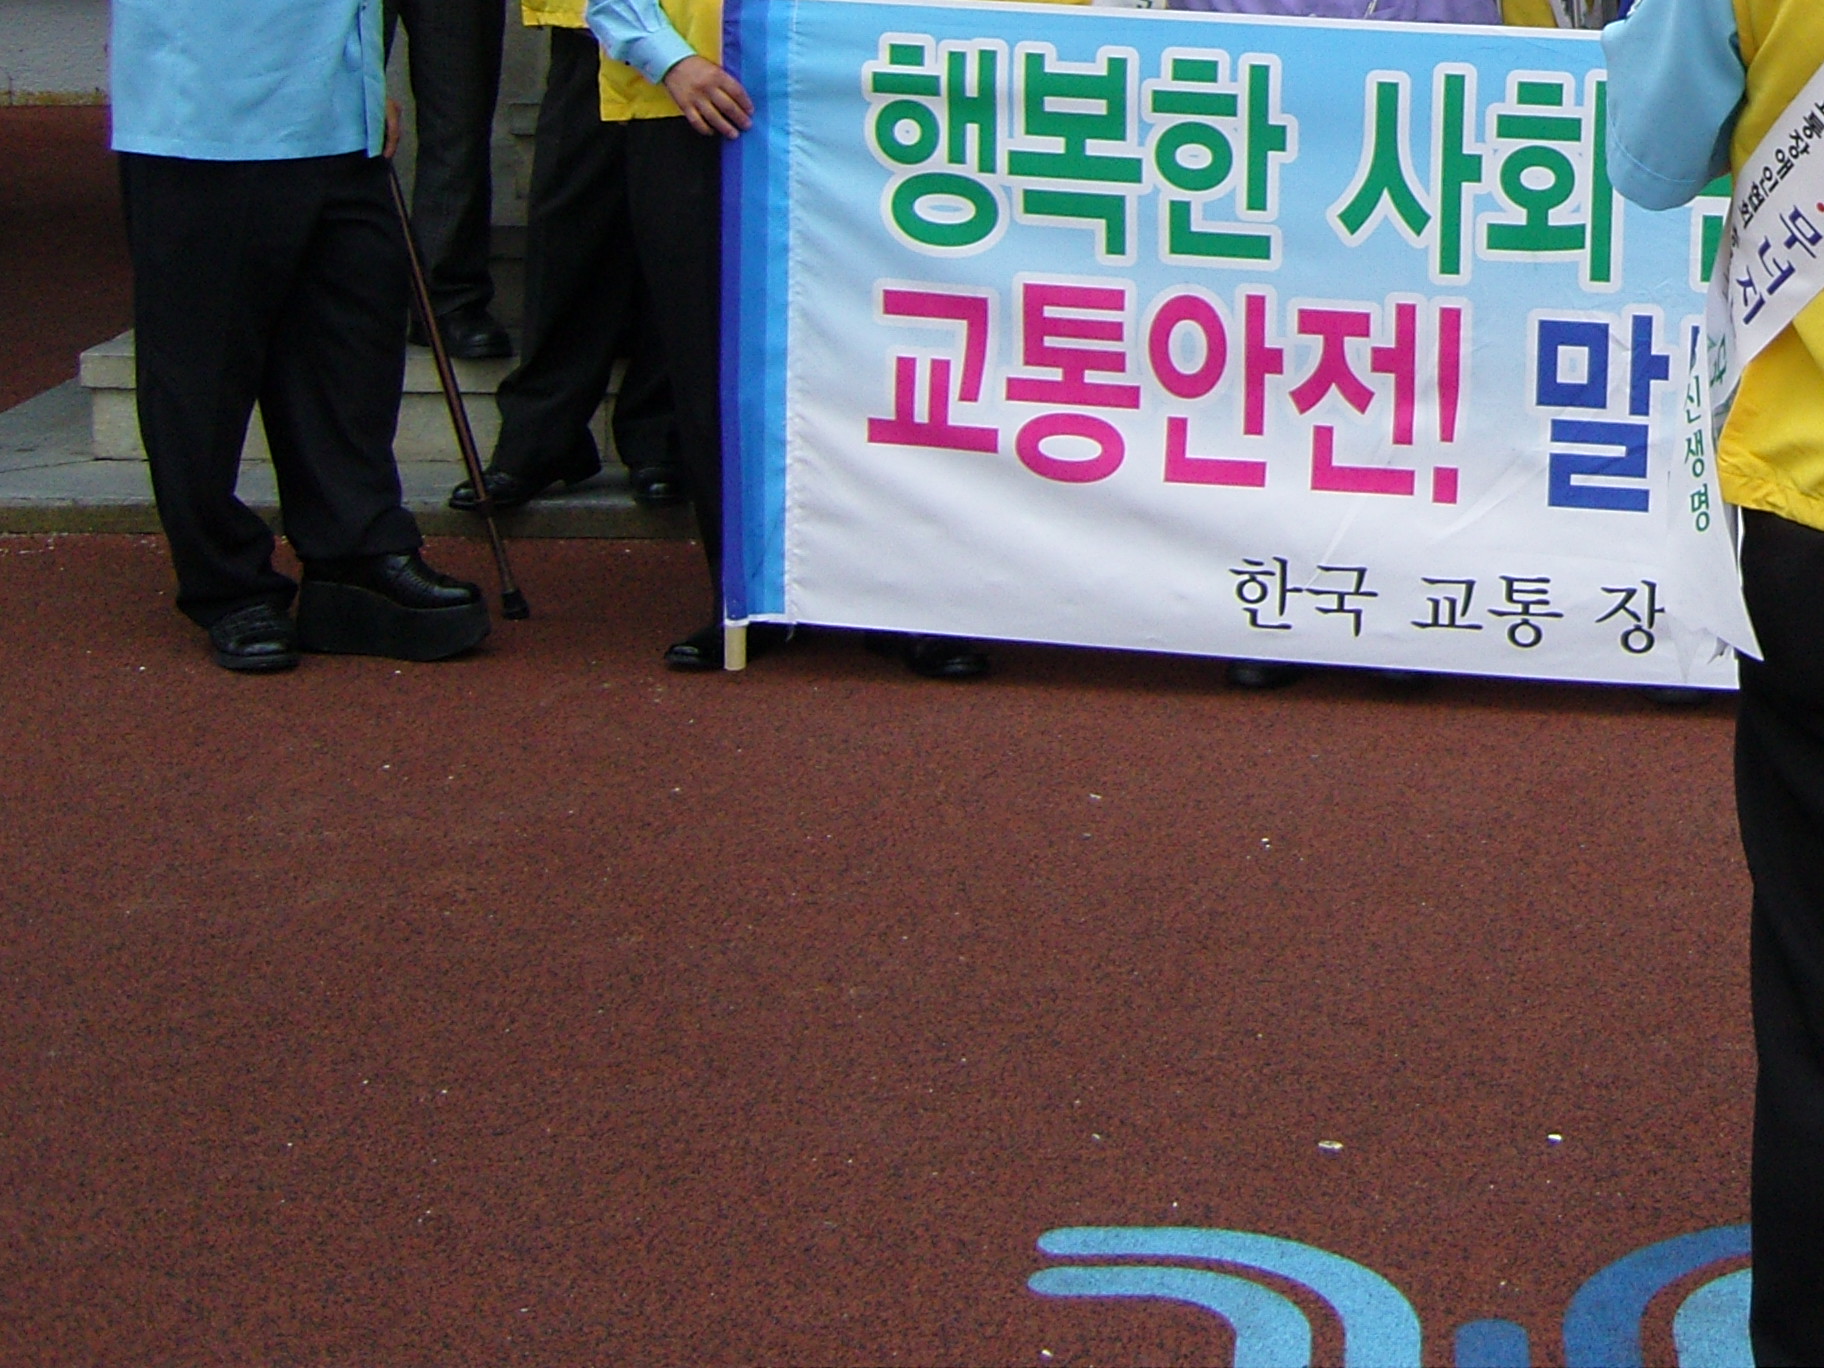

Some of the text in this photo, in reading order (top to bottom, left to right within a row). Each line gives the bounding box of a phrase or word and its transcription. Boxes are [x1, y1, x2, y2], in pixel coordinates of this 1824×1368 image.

[865, 44, 1287, 260] 행복한
[1334, 74, 1613, 282] 사회
[1736, 205, 1823, 325] 무너지
[866, 284, 1461, 503] 교통안전!
[1535, 314, 1700, 513] 말
[1229, 556, 1379, 638] 한국
[1410, 575, 1564, 649] 교통
